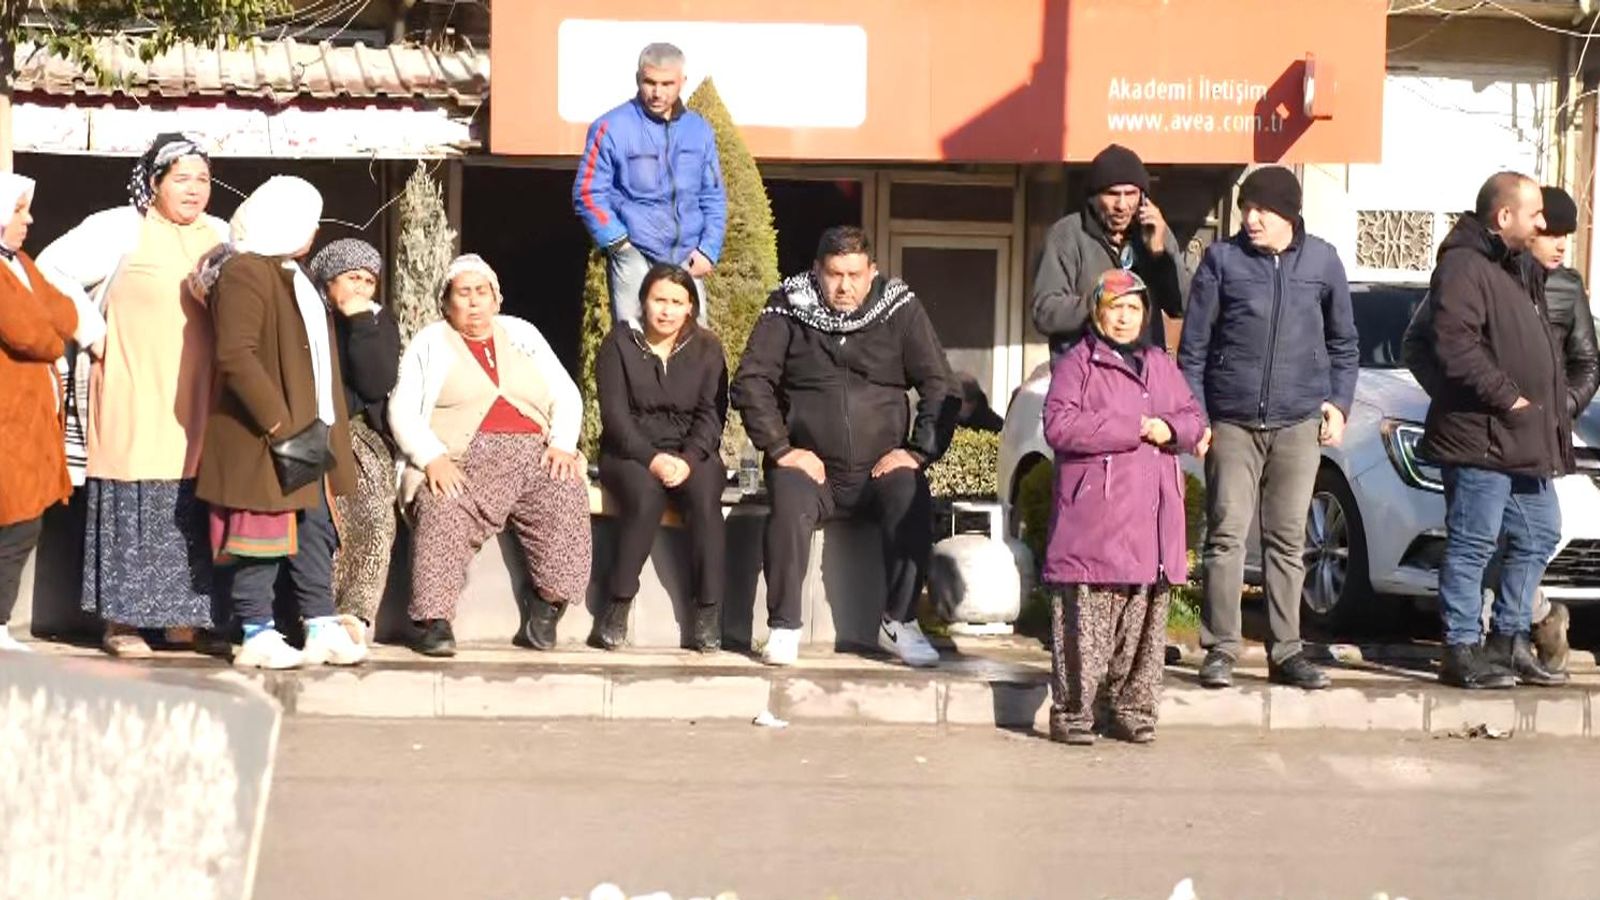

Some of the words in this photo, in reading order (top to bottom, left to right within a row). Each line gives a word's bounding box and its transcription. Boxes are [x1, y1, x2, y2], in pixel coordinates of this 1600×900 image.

[1108, 78, 1192, 101] Akademi
[1199, 75, 1268, 104] İletişim
[1107, 111, 1284, 132] www.avea.com.tr
